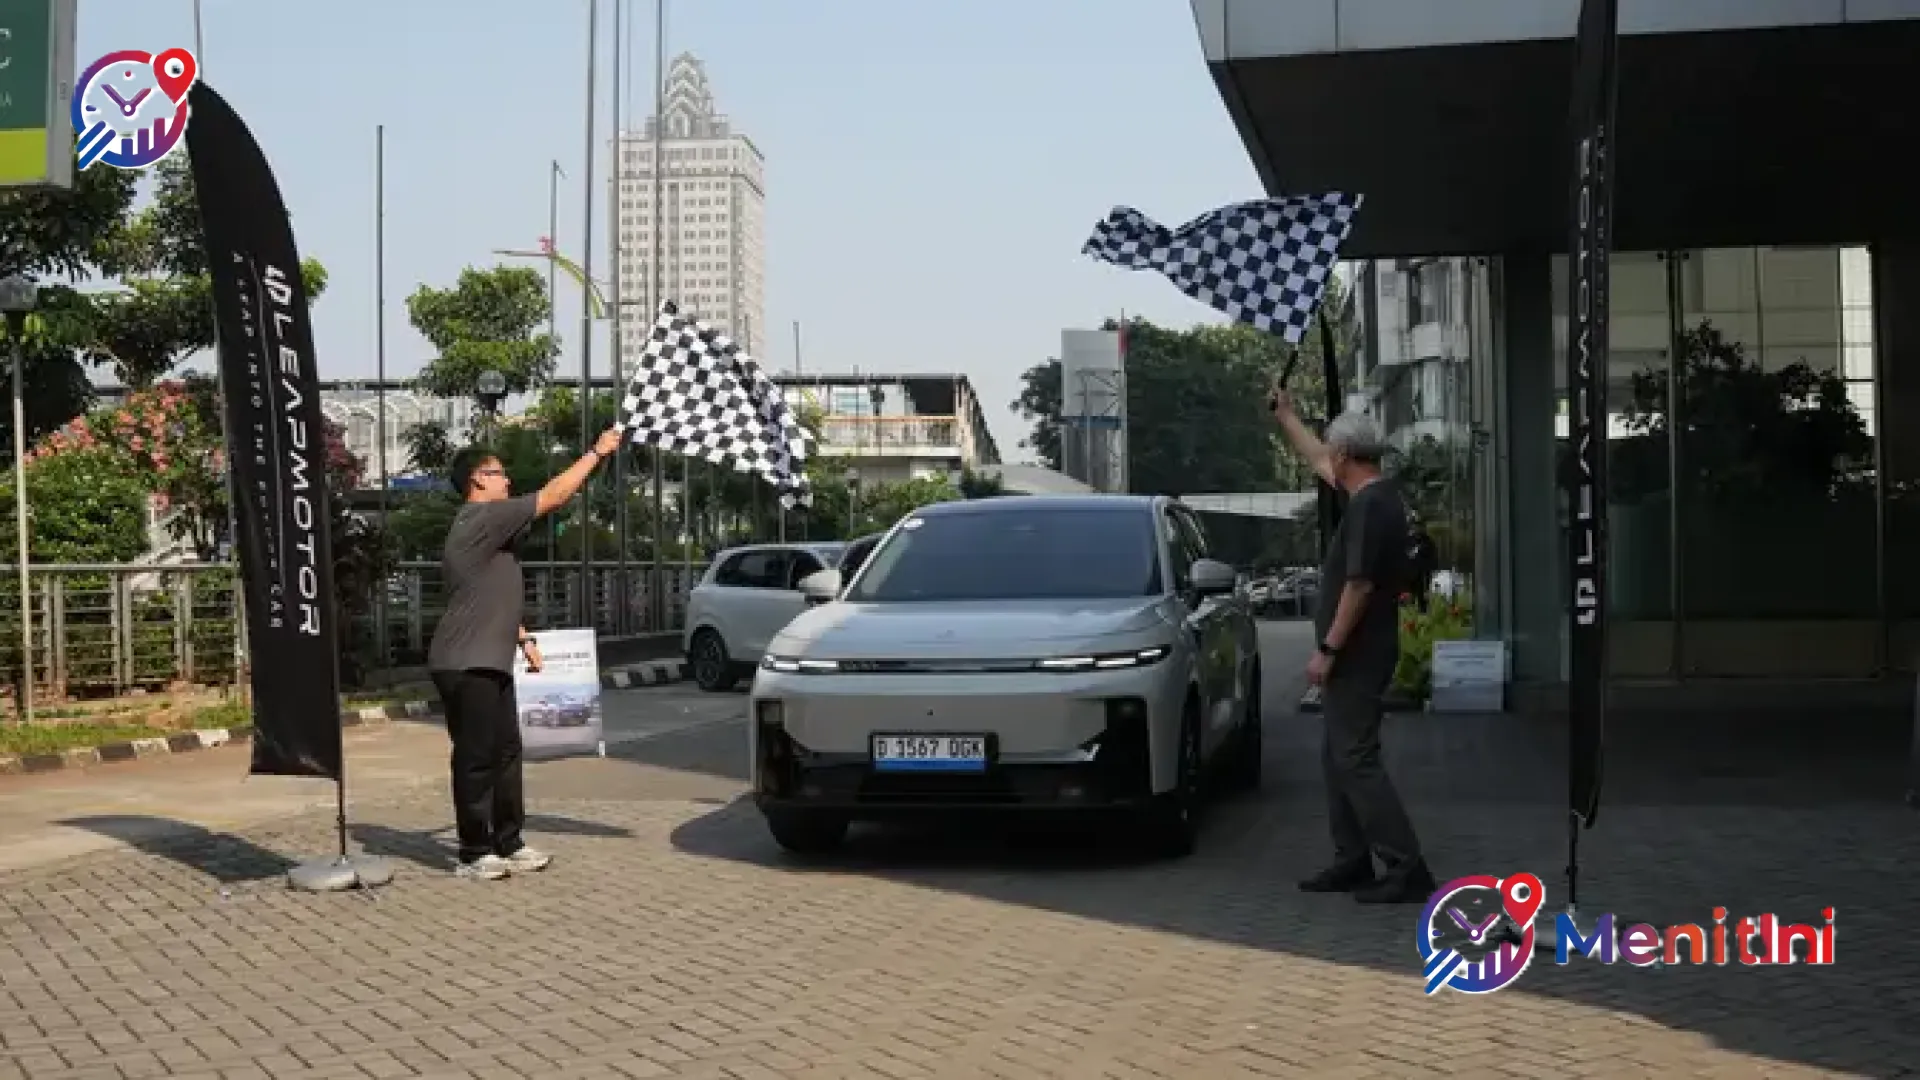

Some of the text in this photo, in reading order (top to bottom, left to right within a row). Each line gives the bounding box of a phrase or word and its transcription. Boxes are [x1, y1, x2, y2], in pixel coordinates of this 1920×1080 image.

[248, 352, 263, 408] INTO
[254, 422, 267, 465] THE
[274, 311, 320, 636] LEAPMOTOR
[269, 584, 284, 627] CAR
